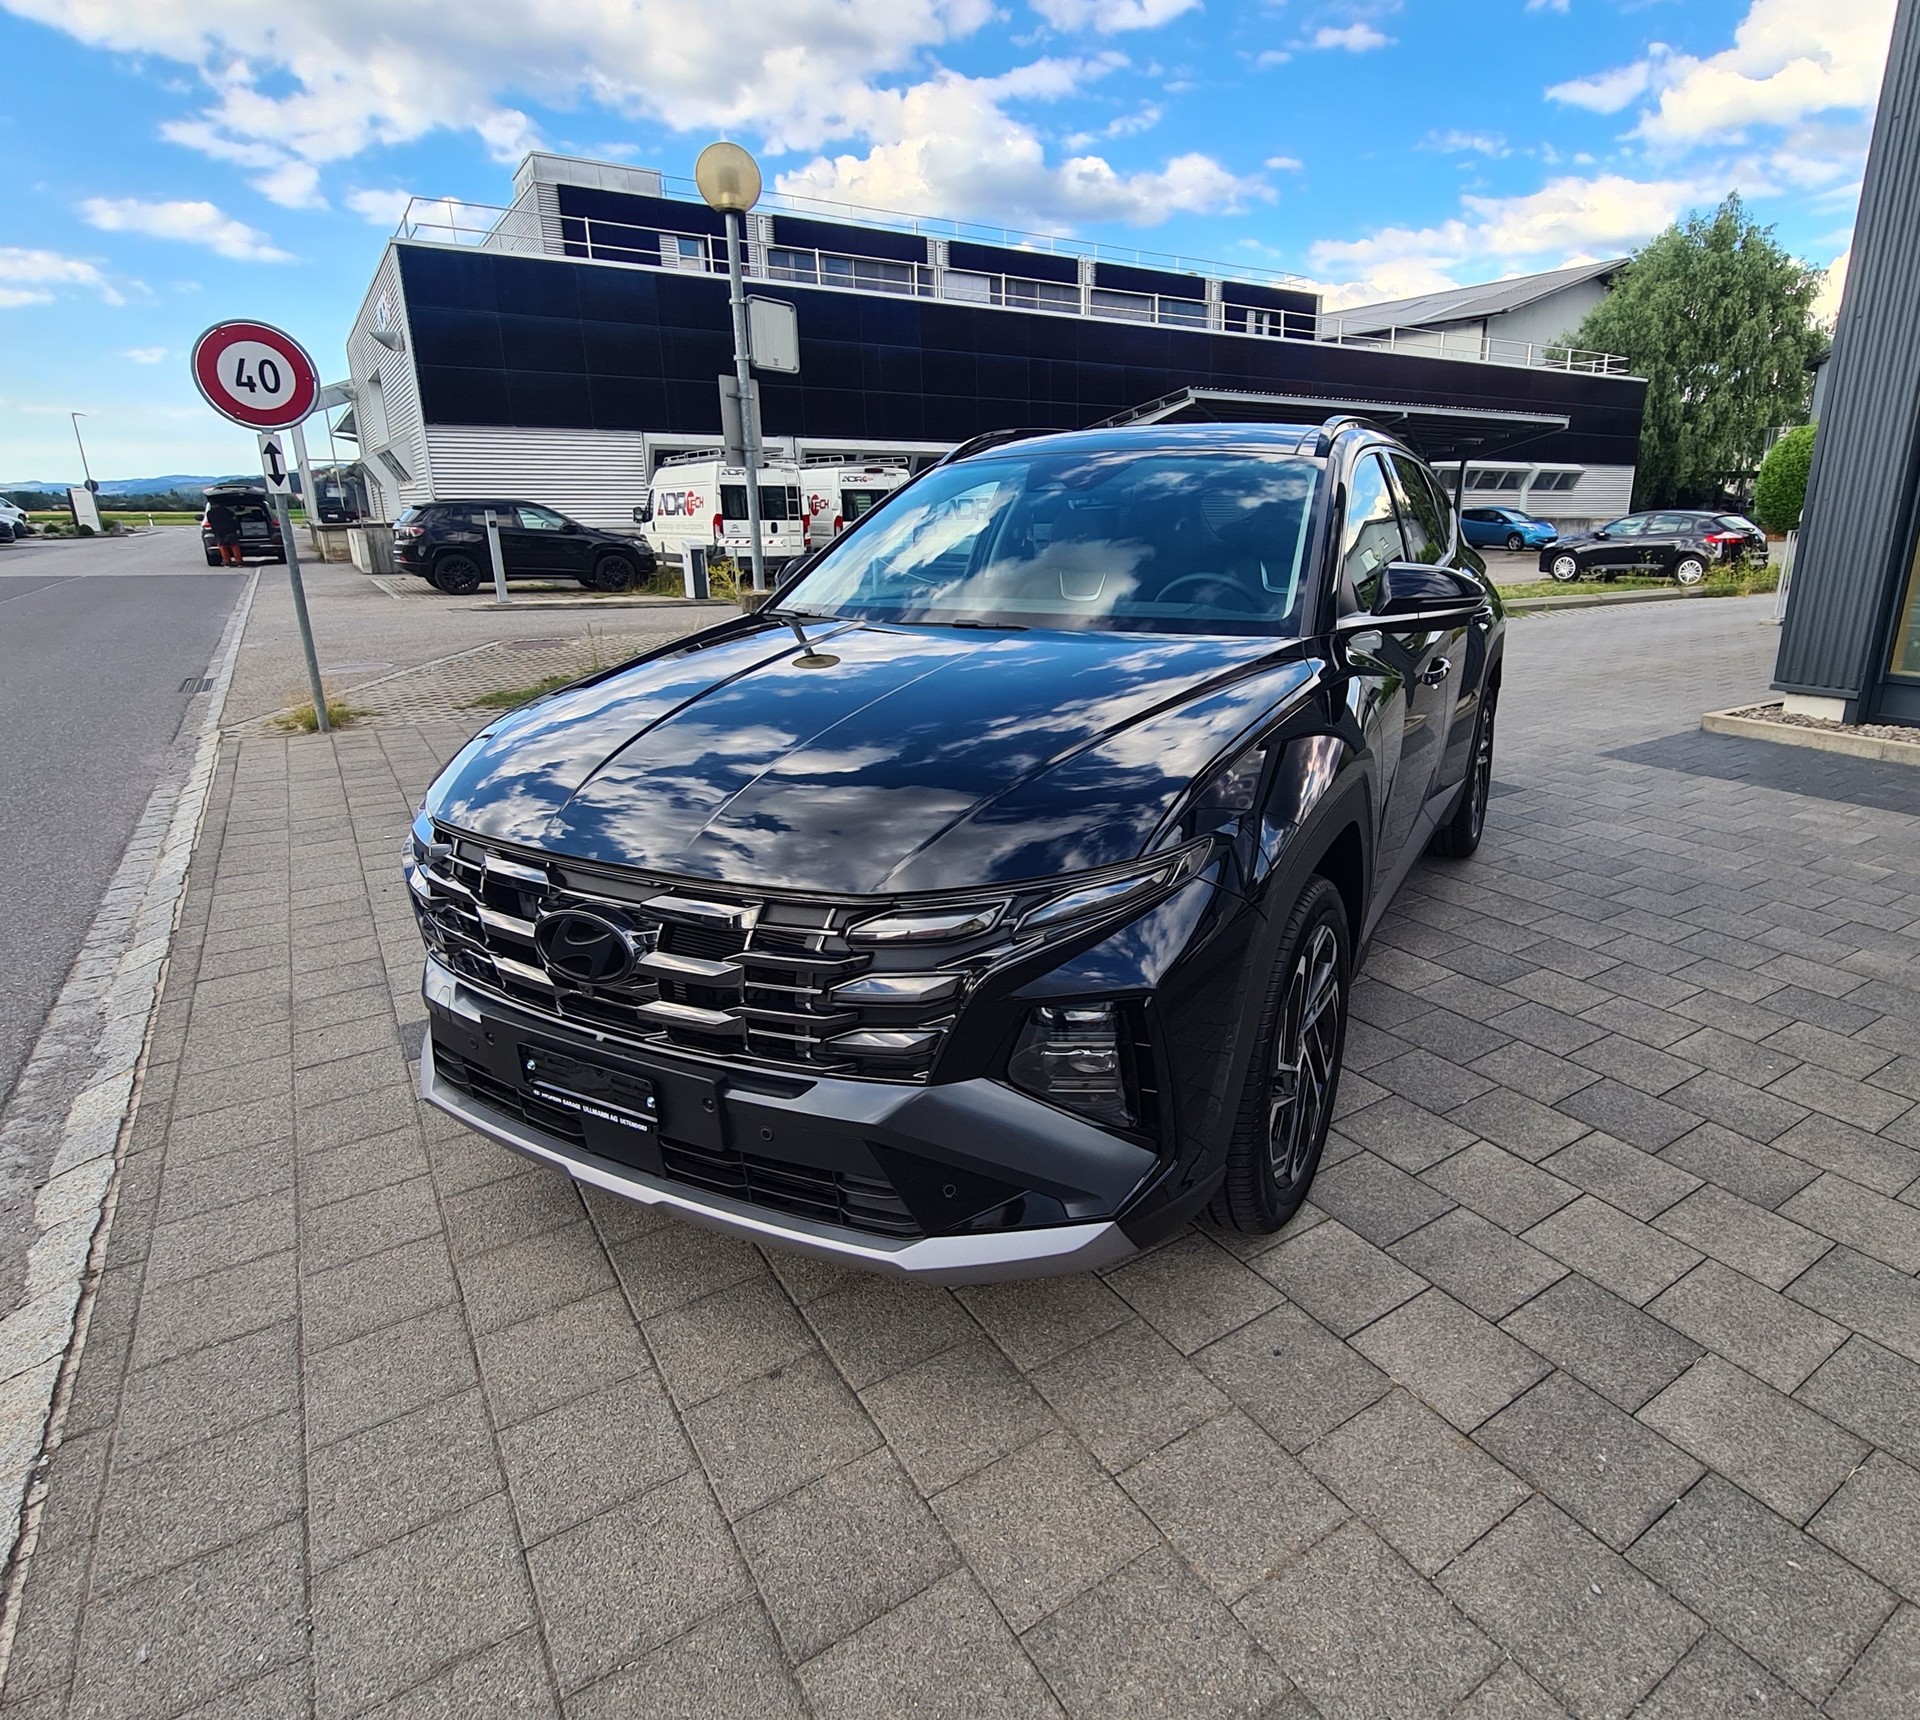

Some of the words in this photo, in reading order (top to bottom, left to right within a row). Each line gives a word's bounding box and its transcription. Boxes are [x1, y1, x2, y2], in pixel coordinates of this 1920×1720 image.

[236, 358, 280, 394] 40
[562, 1099, 581, 1110] GARAGE
[582, 1105, 609, 1119] ULLMANN
[609, 1114, 619, 1123] AG
